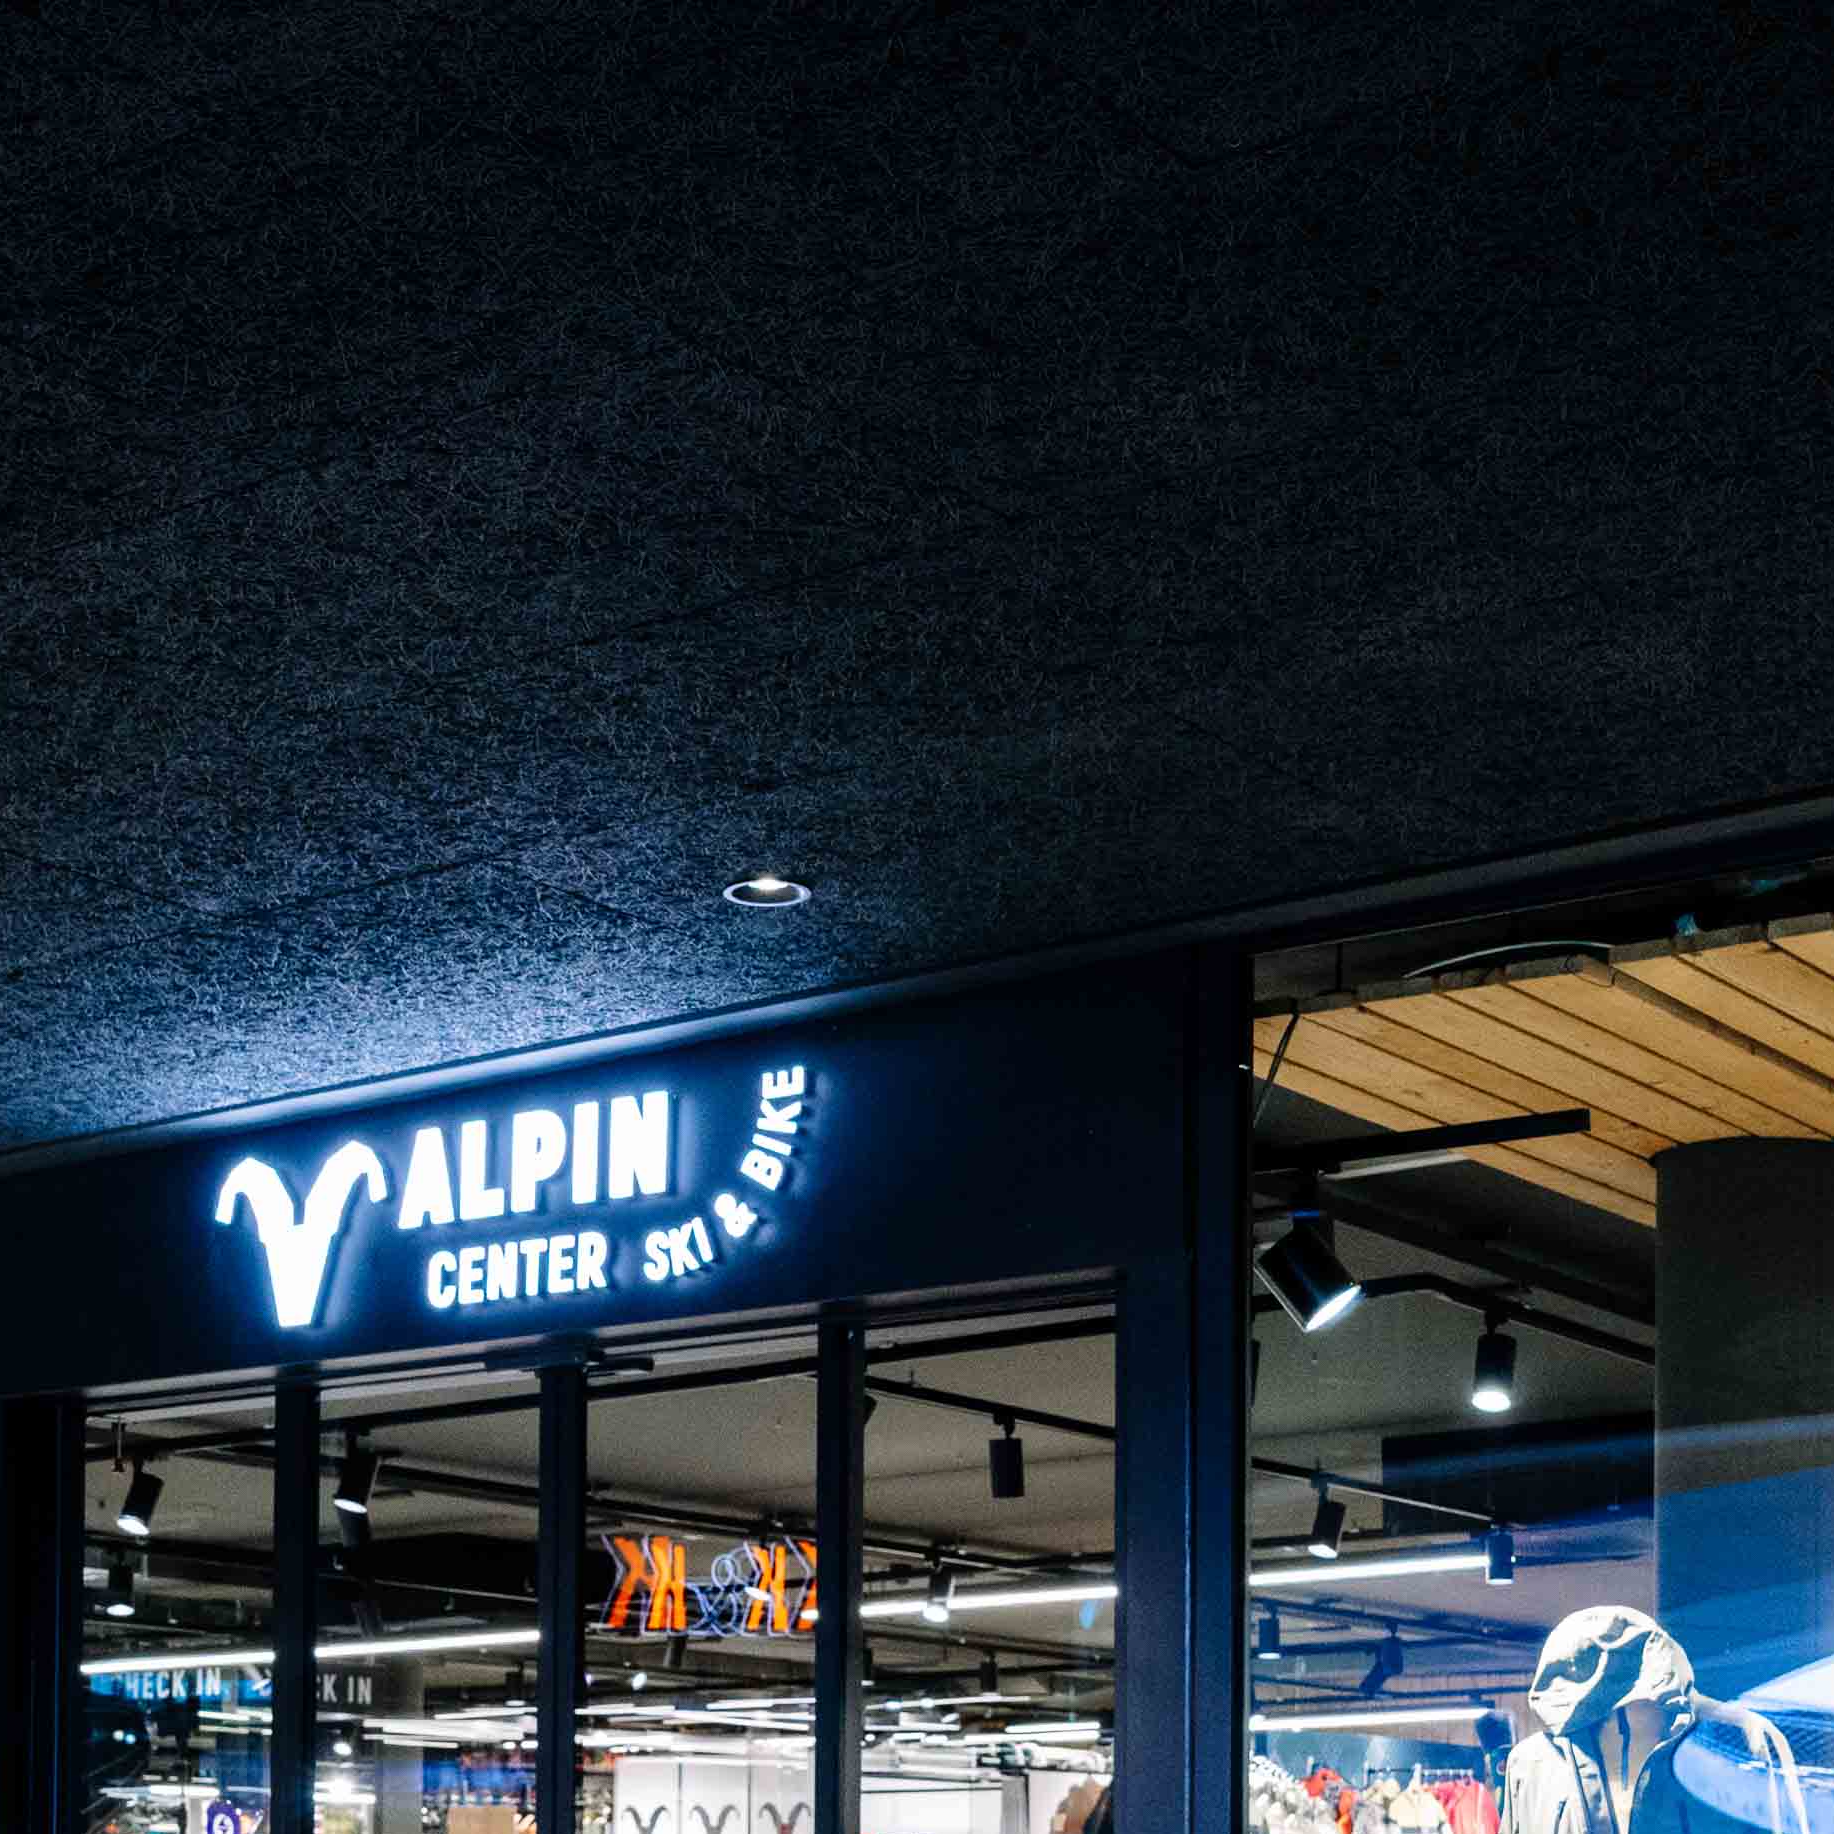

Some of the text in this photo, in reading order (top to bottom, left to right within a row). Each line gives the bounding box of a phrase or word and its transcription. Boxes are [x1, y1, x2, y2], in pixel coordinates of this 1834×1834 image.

[398, 1090, 669, 1230] ALPIN
[427, 1065, 805, 1309] CENTER SKI & BIKE
[195, 1666, 222, 1697] IN
[347, 1675, 373, 1705] IN
